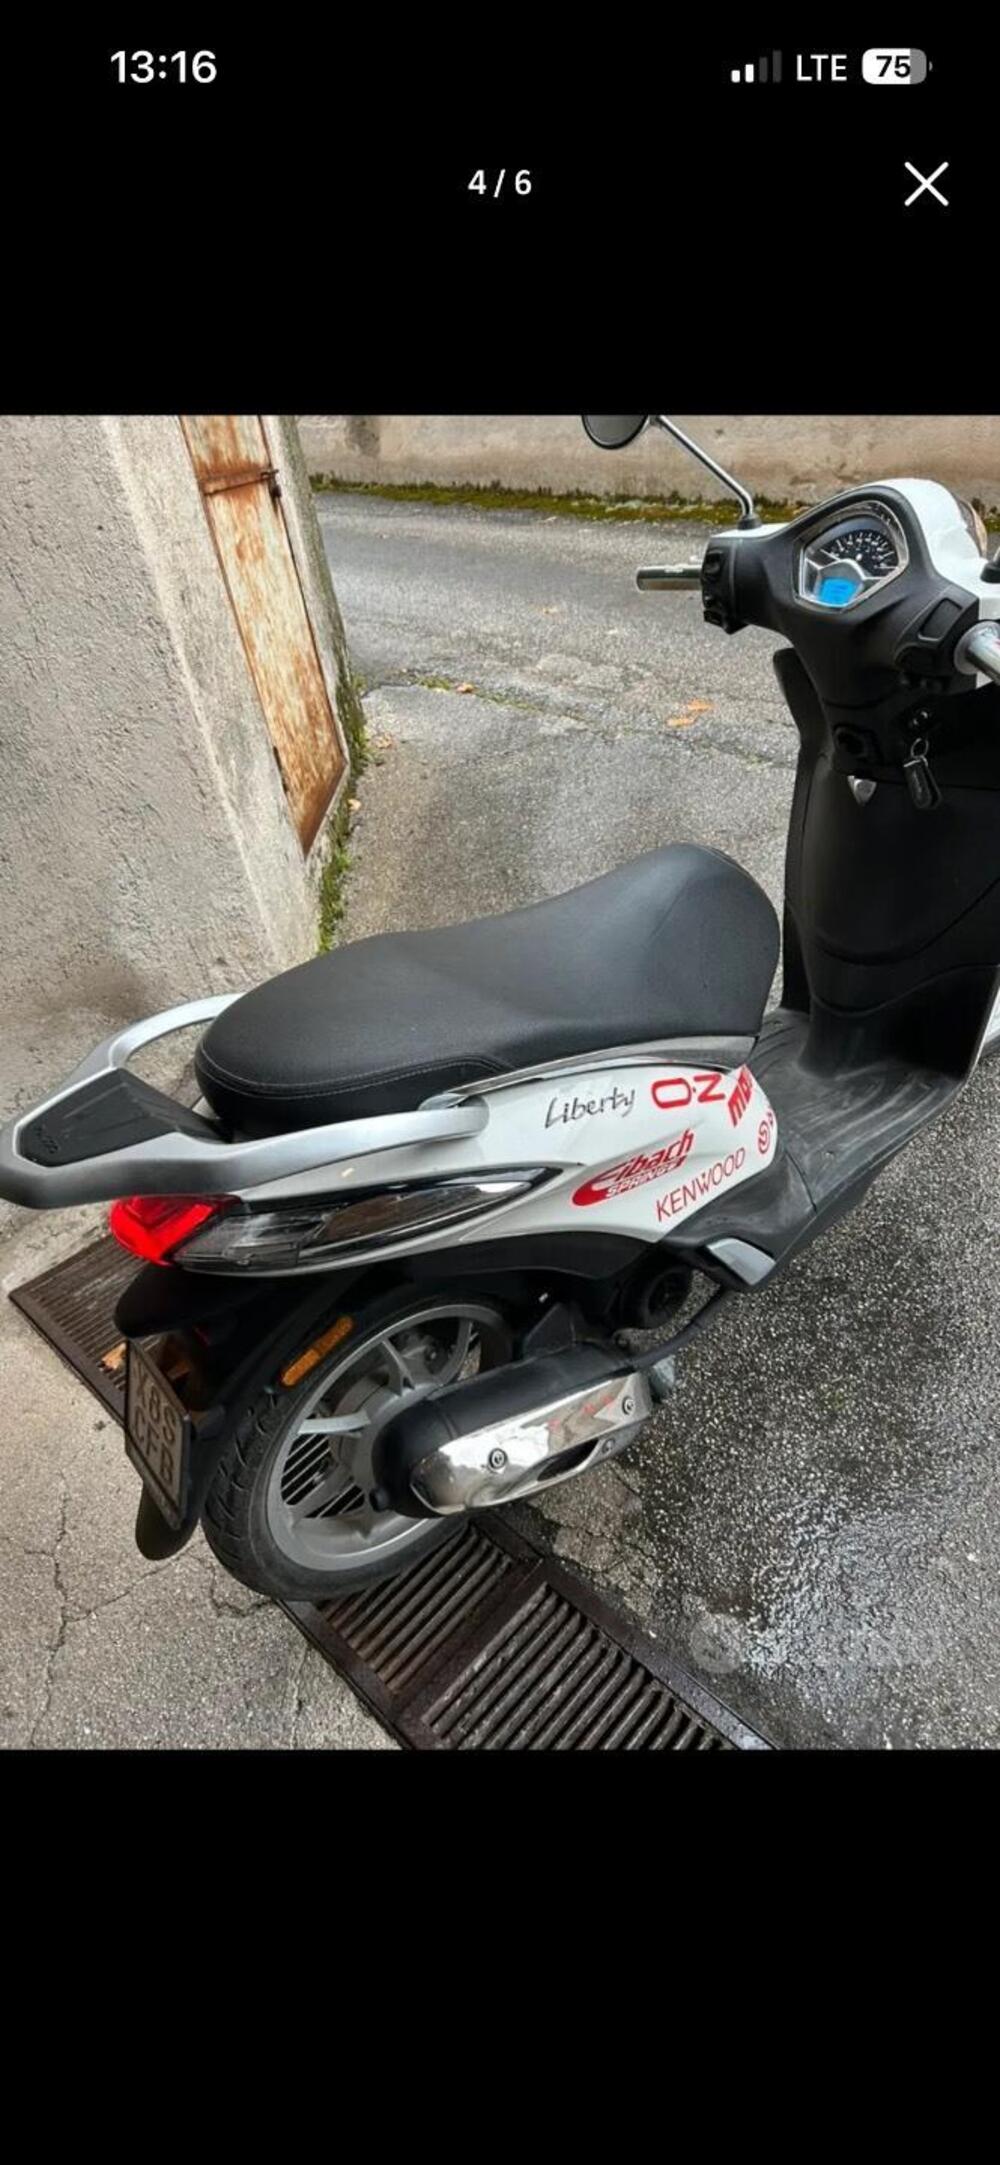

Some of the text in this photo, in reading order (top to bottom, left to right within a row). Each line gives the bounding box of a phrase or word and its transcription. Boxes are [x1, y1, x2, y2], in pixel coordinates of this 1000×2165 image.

[544, 1086, 635, 1129] Liberty
[572, 1127, 695, 1206] Eibach
[655, 1147, 746, 1222] KENWOOD
